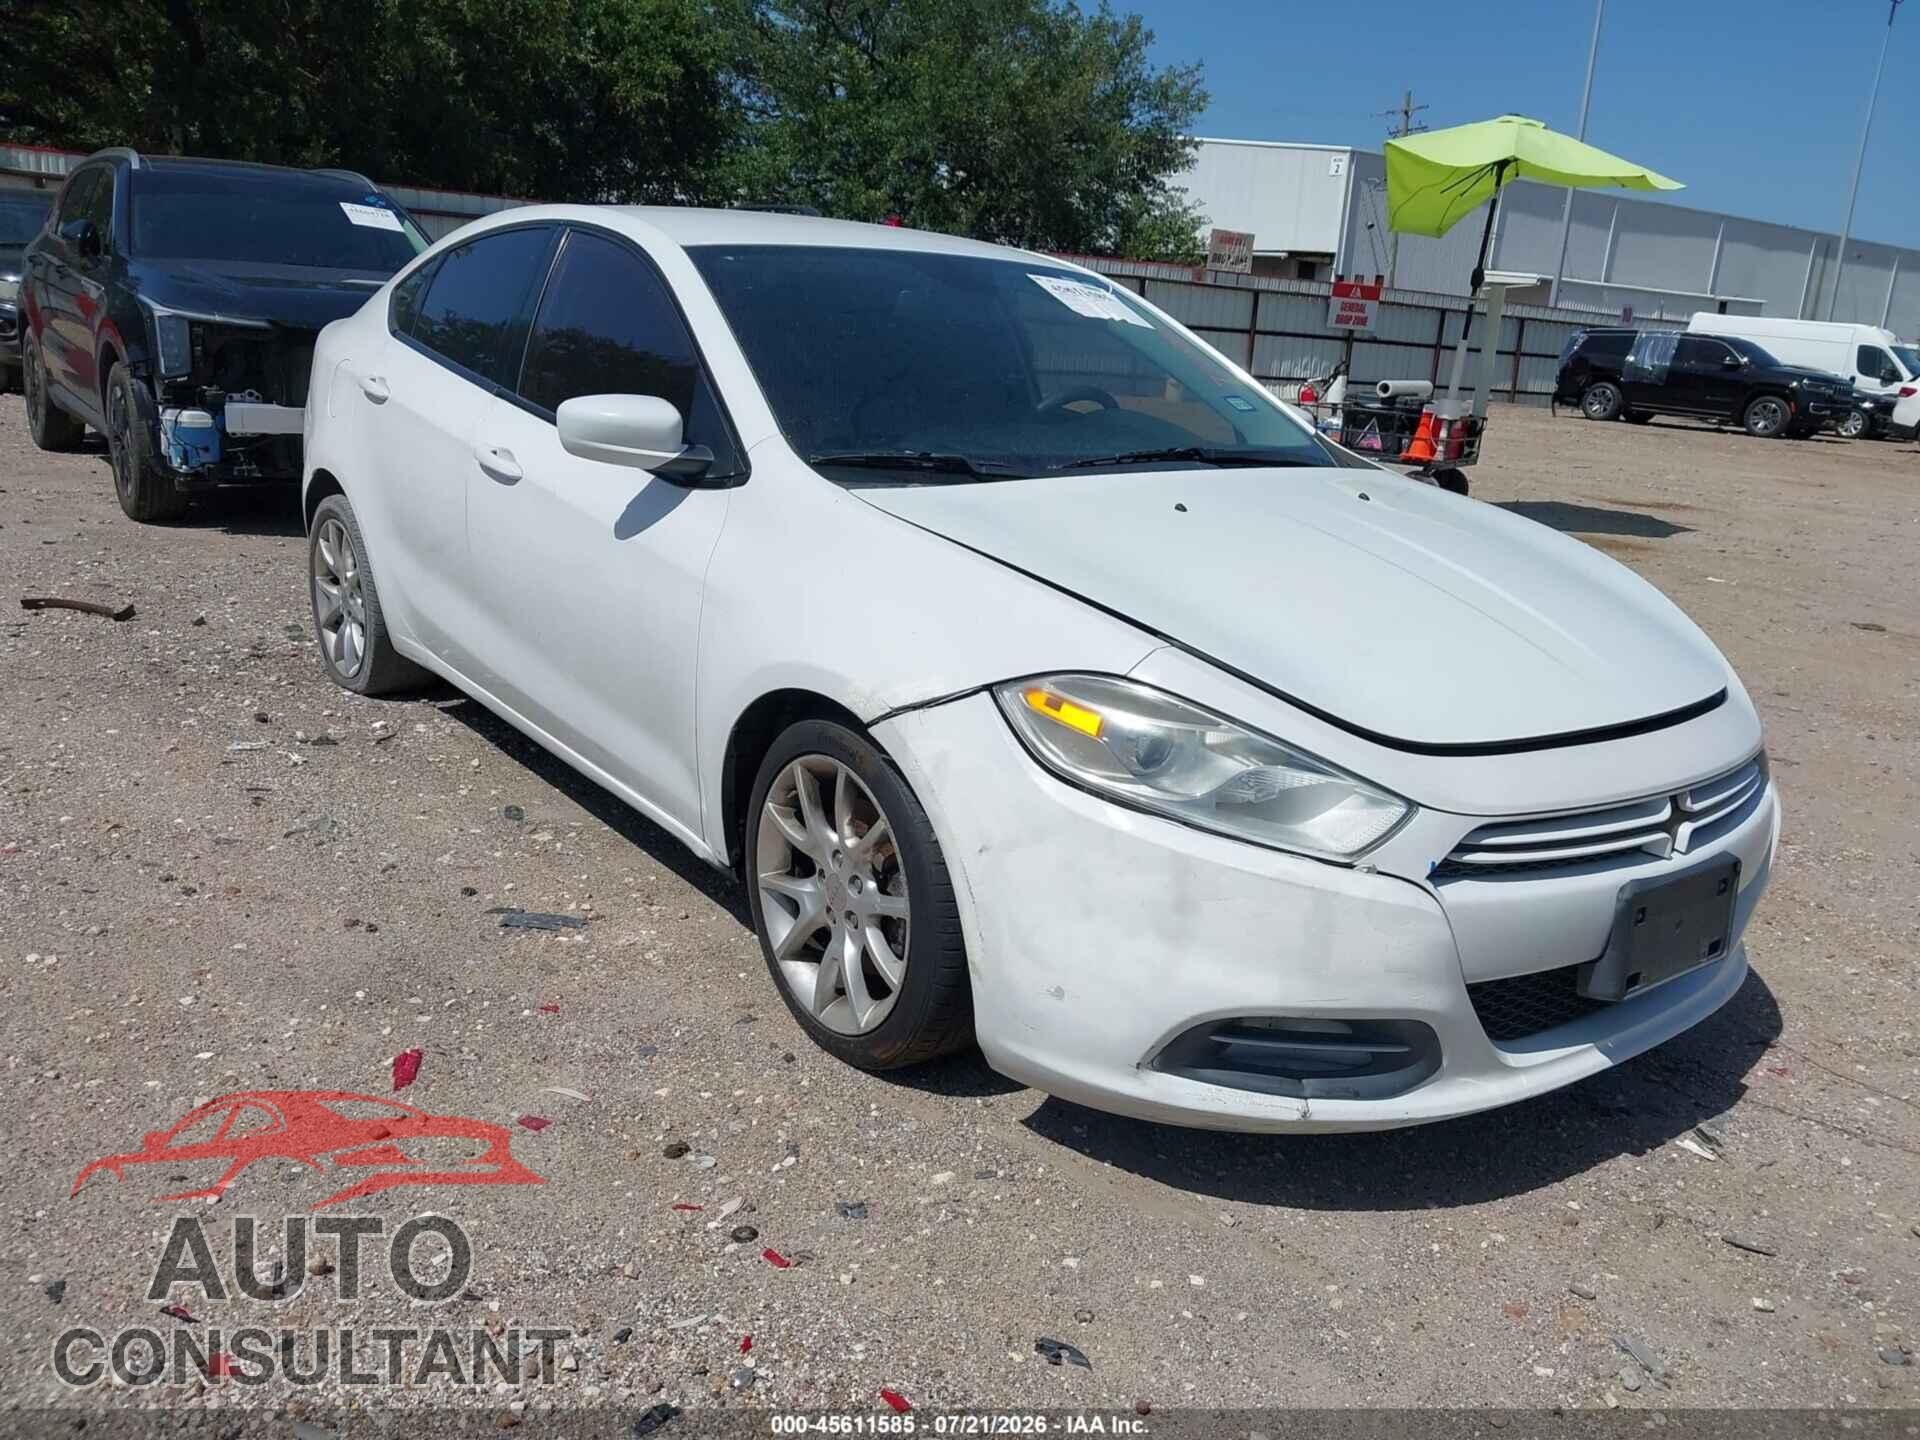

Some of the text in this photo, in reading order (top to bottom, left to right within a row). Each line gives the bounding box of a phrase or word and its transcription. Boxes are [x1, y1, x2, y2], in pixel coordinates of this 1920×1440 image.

[1340, 301, 1367, 314] GENERAL
[1335, 314, 1368, 327] DROP ZONE
